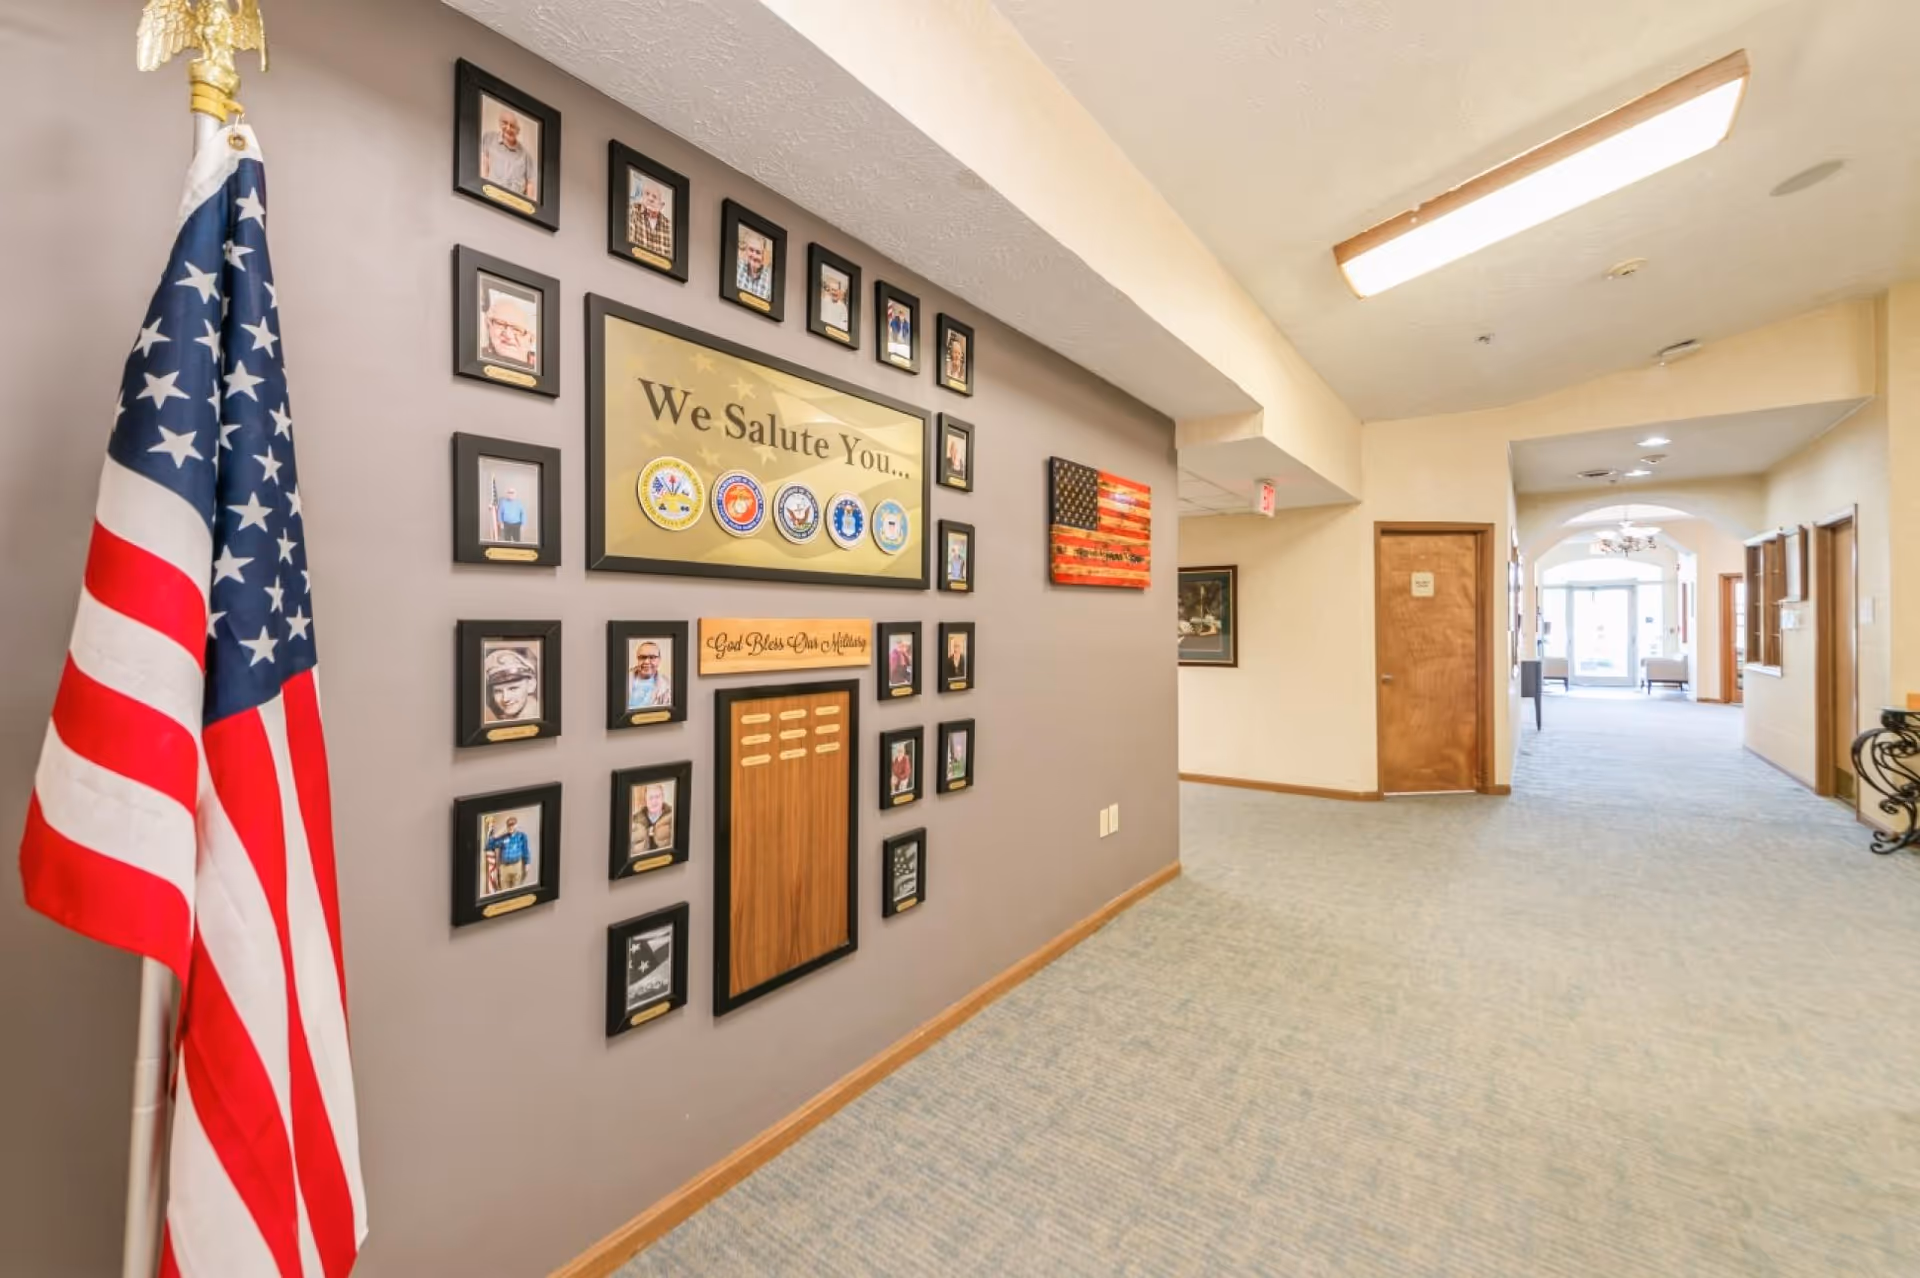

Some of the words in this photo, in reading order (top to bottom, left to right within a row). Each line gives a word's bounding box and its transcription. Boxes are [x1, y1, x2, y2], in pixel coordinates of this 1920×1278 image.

[637, 377, 711, 432] We
[725, 403, 829, 459] Salute
[838, 433, 910, 480] You...
[706, 631, 743, 660] God
[745, 631, 785, 656] Bless
[787, 631, 818, 654] Our
[821, 631, 867, 656] Military
